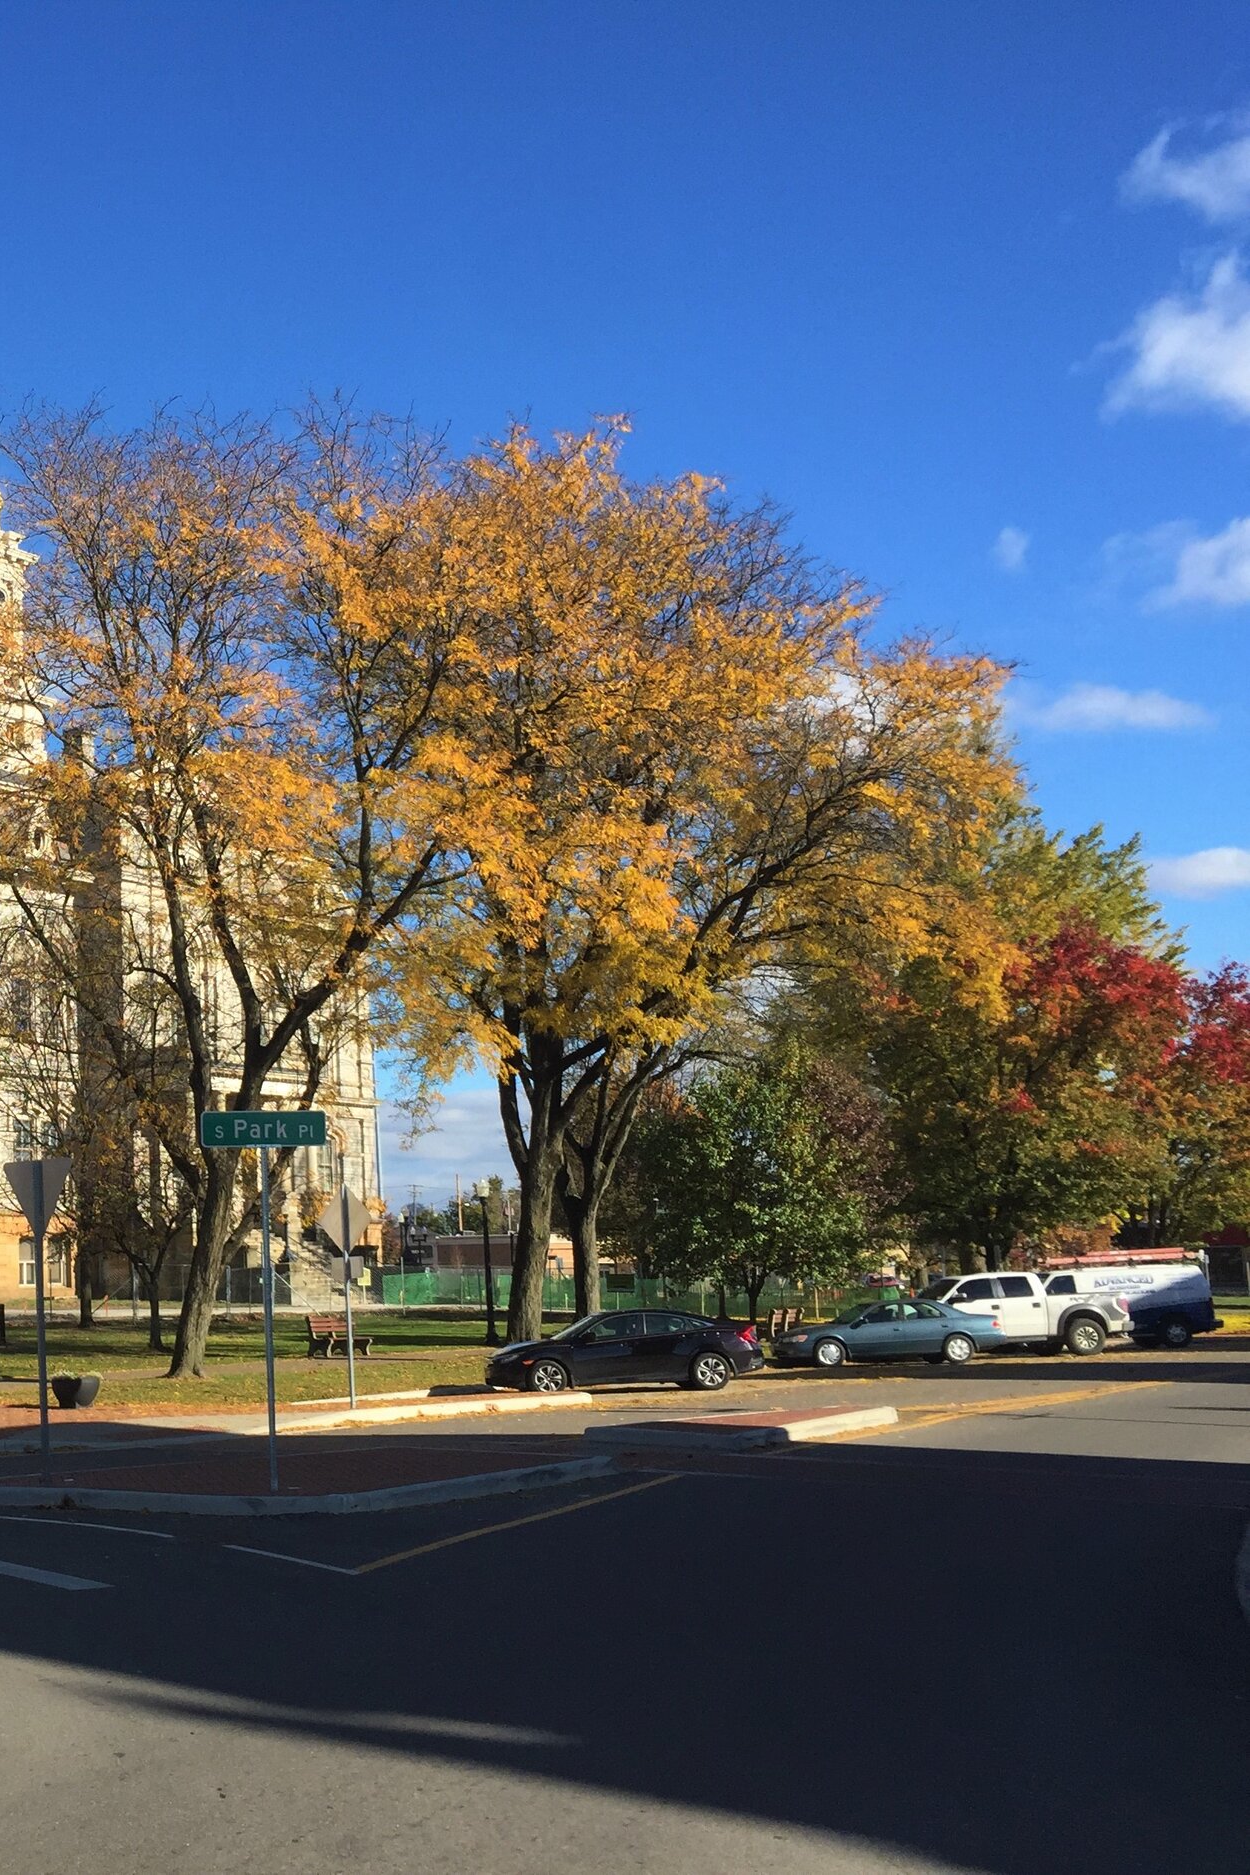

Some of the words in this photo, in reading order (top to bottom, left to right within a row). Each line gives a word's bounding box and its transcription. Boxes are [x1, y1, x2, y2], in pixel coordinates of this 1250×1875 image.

[234, 1119, 287, 1139] Park
[299, 1125, 314, 1139] Pl
[1094, 1273, 1154, 1288] ADVANCED
